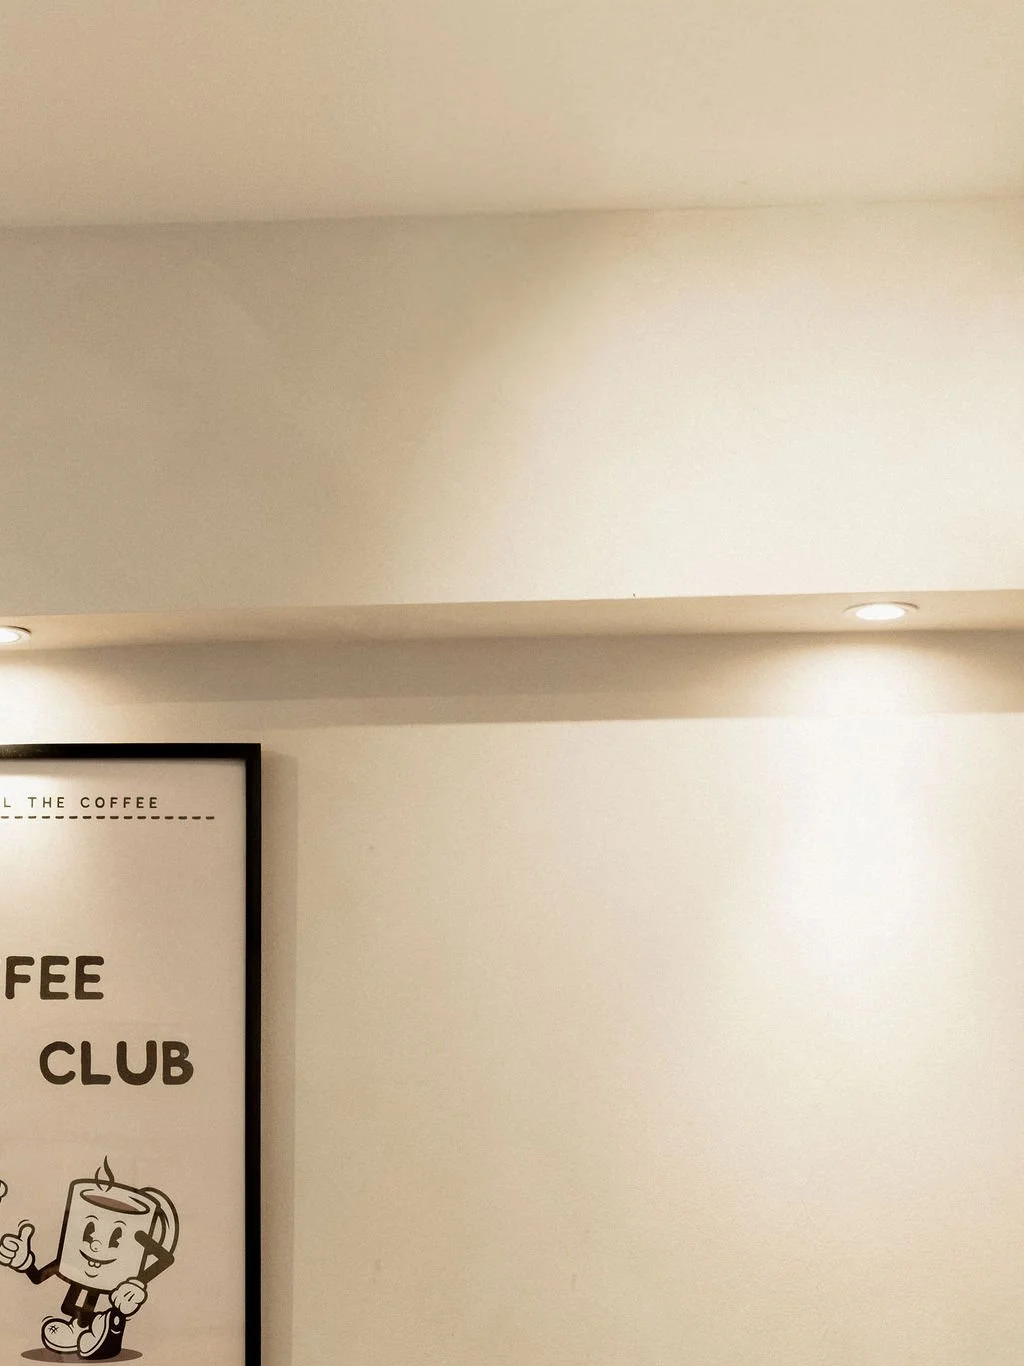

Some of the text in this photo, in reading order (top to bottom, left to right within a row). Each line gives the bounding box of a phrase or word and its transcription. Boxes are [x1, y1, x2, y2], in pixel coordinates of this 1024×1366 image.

[27, 796, 65, 809] THE
[80, 796, 158, 809] COFFEE
[38, 1039, 195, 1087] CLUB
